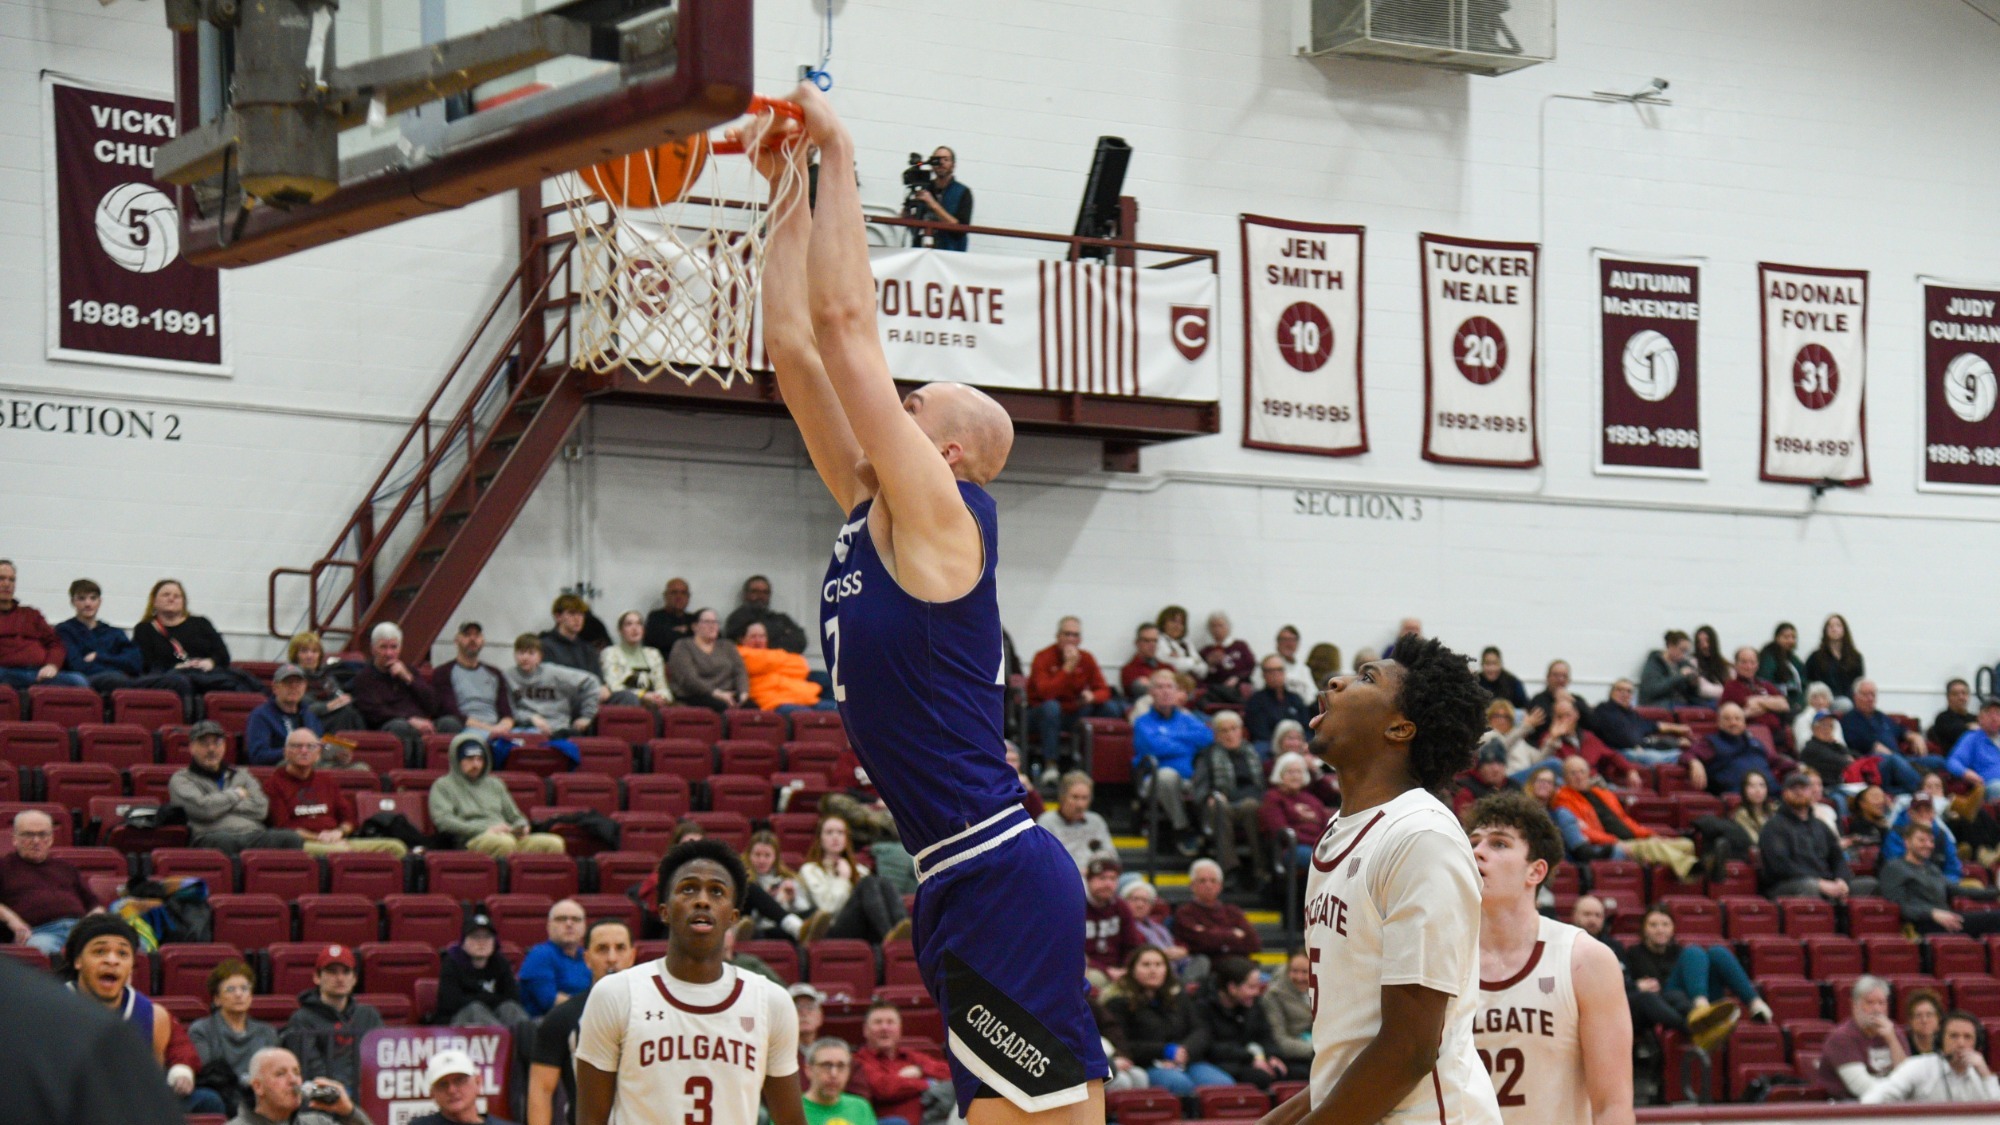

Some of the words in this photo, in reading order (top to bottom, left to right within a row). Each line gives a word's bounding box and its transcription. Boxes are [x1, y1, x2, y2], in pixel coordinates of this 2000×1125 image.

[90, 104, 176, 138] VICKY
[129, 208, 149, 246] 5
[1280, 237, 1327, 261] JEN
[1433, 249, 1530, 277] TUCKER
[1267, 265, 1344, 291] SMITH
[1442, 279, 1519, 305] NEALE
[1609, 270, 1691, 294] AUTUMN
[874, 278, 1004, 325] OLGATE
[1771, 281, 1859, 305] ADONAL
[69, 298, 216, 336] 1988-1991
[1603, 295, 1699, 320] McKENZIE
[1782, 309, 1848, 332] FOYLE
[1945, 297, 1995, 318] JUDY
[888, 329, 976, 348] RAIDERS
[1174, 314, 1206, 347] C
[1290, 321, 1320, 354] 10
[1464, 334, 1497, 368] 20
[1645, 353, 1655, 381] 1
[1801, 360, 1829, 393] 31
[1965, 373, 1976, 402] 9
[1262, 398, 1351, 423] 1991-1995
[1437, 411, 1528, 433] 1992-1995
[164, 414, 182, 441] 2
[1776, 436, 1855, 457] 1994-199
[1294, 489, 1404, 520] SECTION
[1410, 498, 1424, 521] 3
[639, 1034, 757, 1072] COLGATE
[966, 1004, 1051, 1078] CRUSADERS
[684, 1075, 714, 1125] 3
